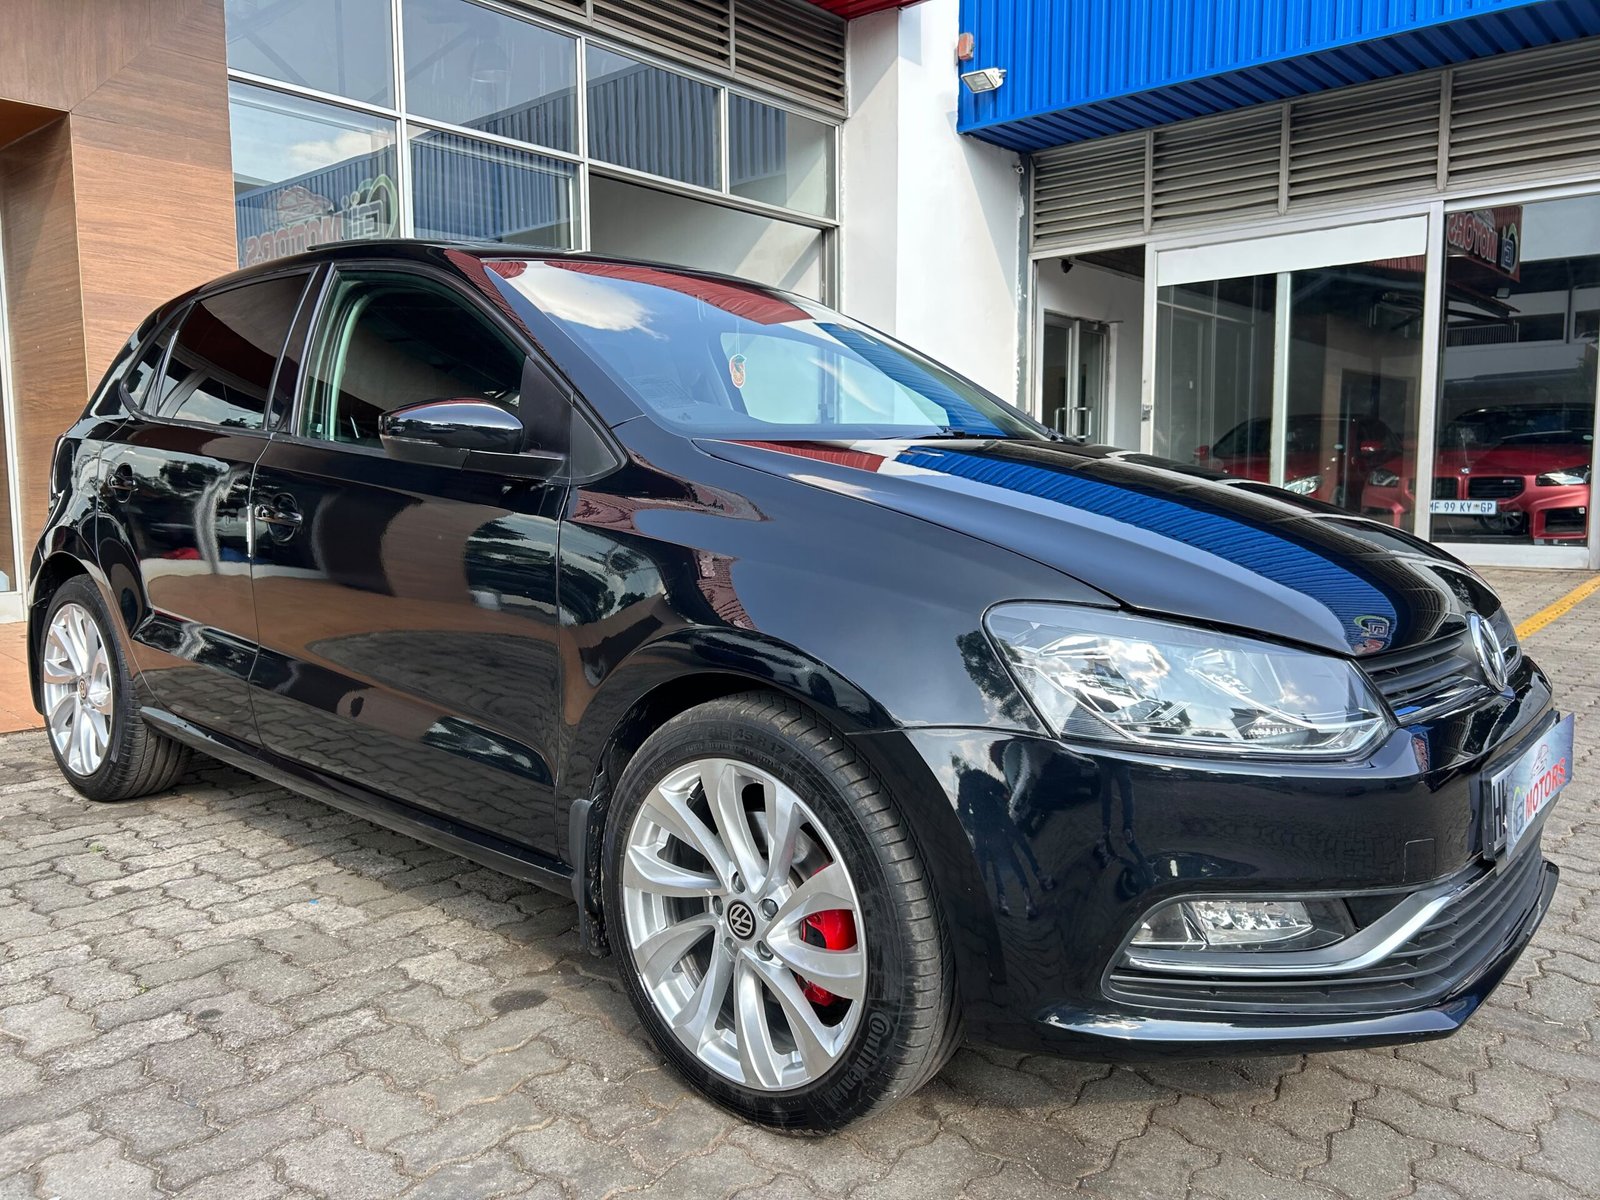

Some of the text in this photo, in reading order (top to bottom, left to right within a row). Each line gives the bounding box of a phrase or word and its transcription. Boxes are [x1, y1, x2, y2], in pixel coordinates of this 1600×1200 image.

[1444, 502, 1456, 511] 99
[1460, 502, 1472, 511] KY
[1480, 503, 1493, 512] GP
[1525, 757, 1566, 822] MOTORS
